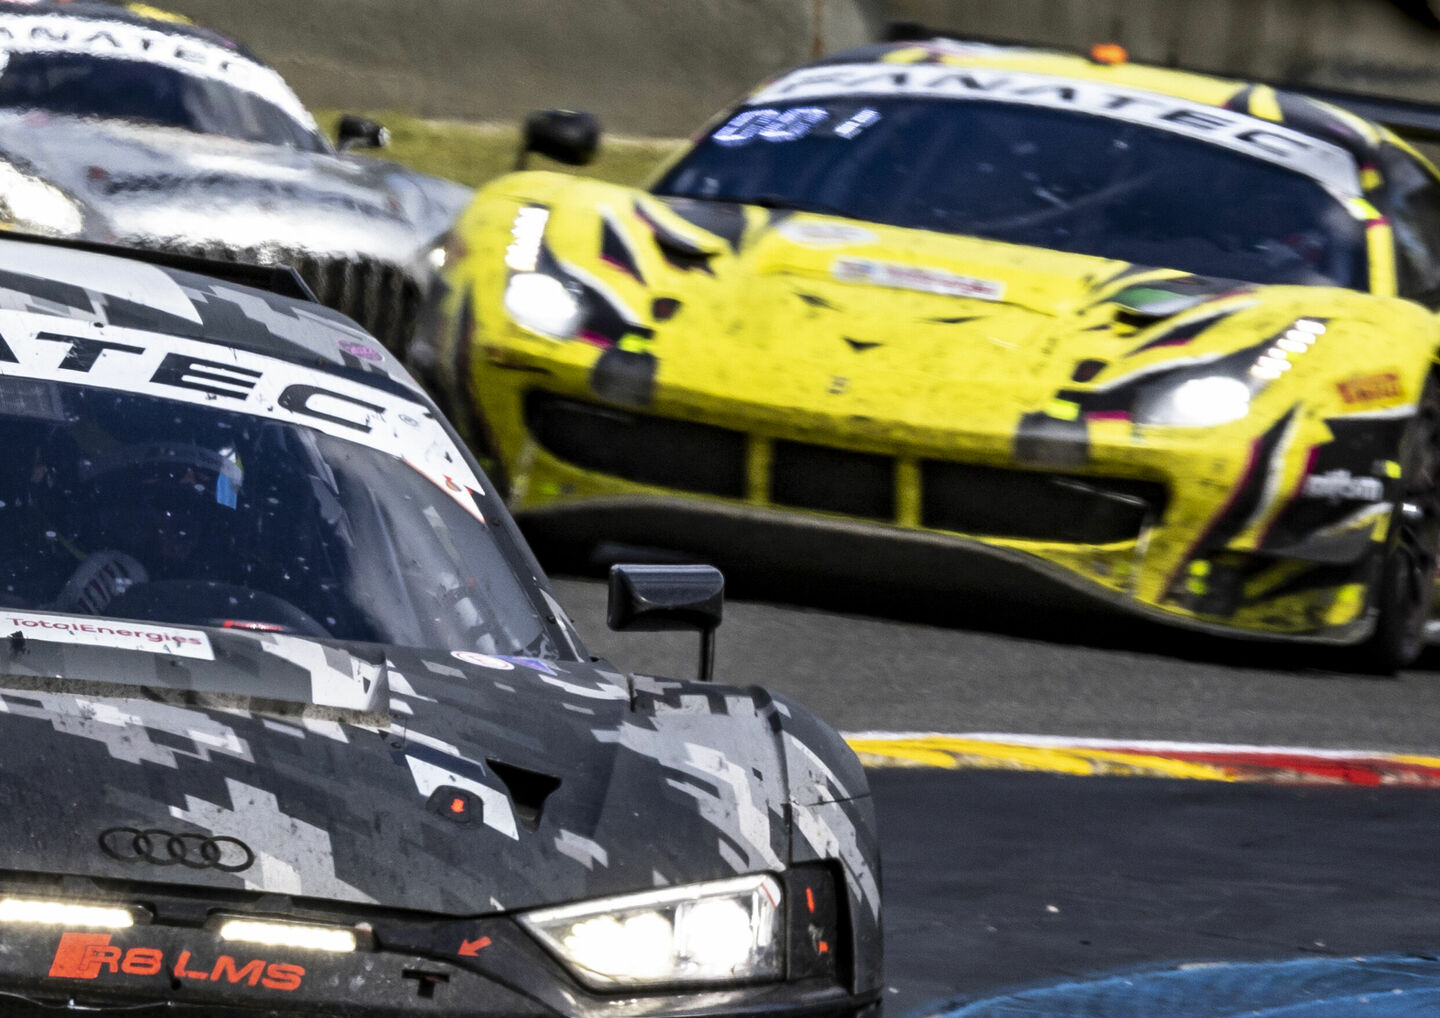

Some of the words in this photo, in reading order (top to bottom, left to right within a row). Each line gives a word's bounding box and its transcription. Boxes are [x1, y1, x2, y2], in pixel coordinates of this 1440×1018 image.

[6, 616, 203, 646] TotalEnergies
[78, 943, 164, 976] R8
[173, 949, 307, 992] LMS
